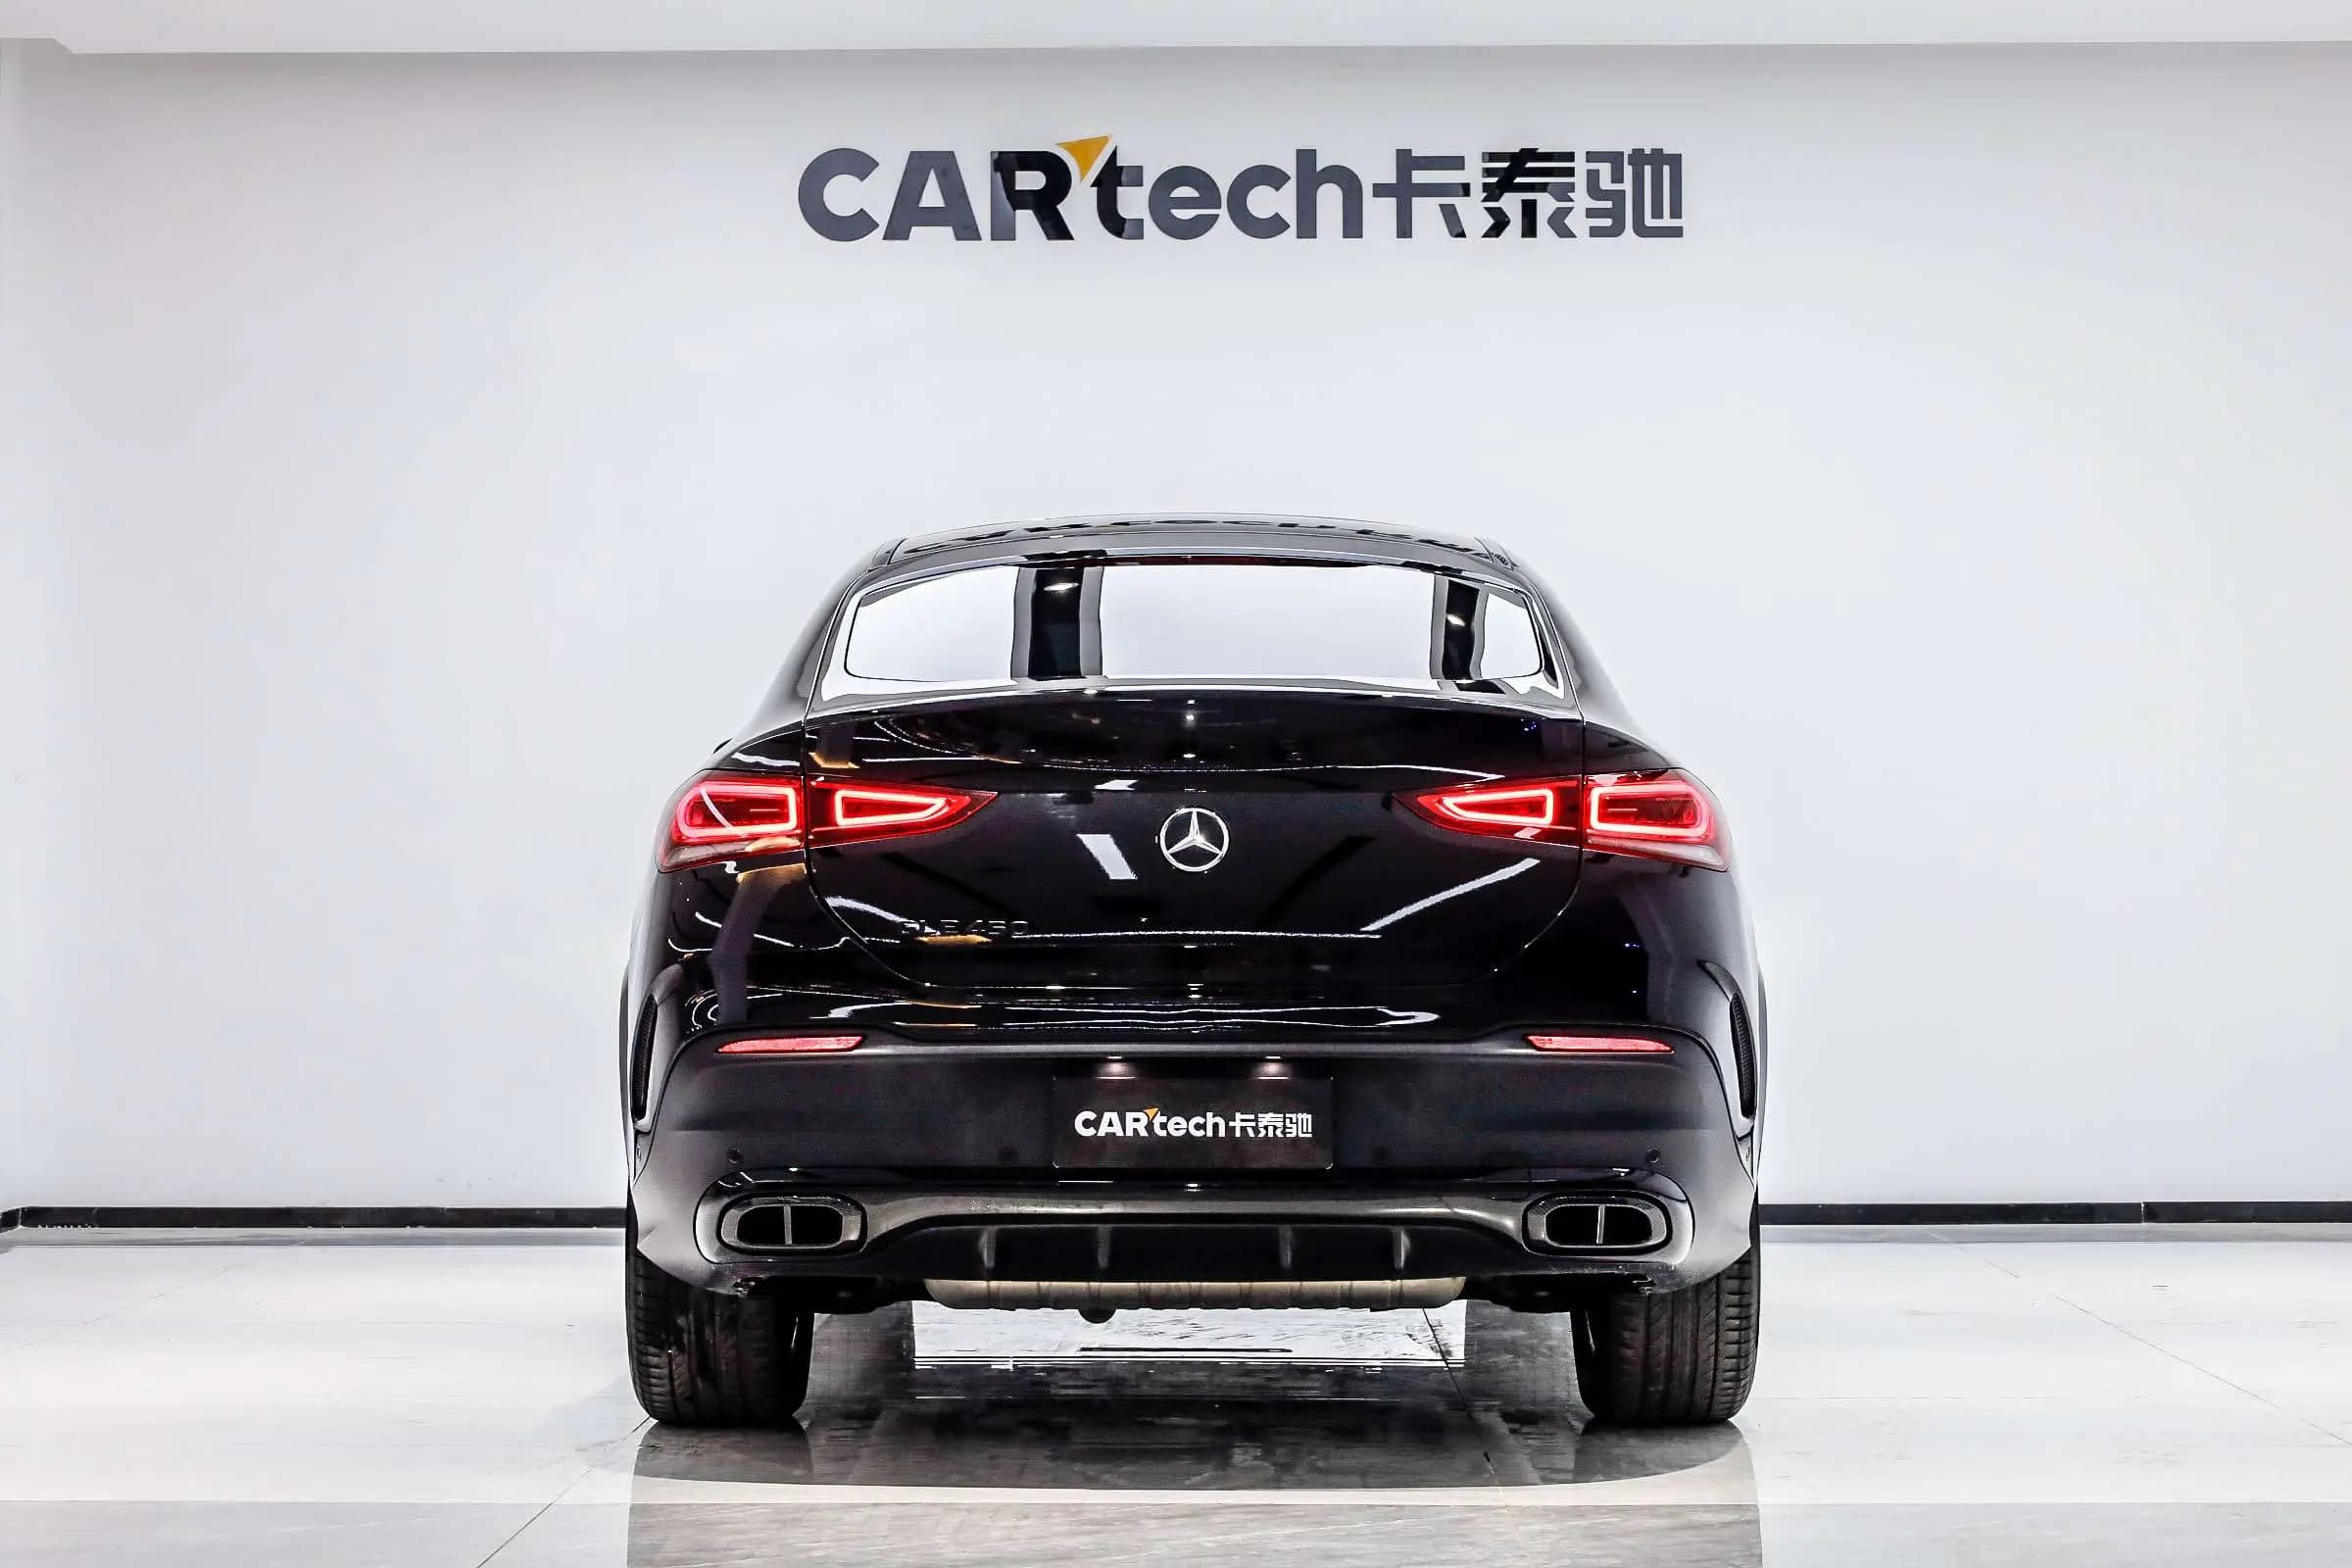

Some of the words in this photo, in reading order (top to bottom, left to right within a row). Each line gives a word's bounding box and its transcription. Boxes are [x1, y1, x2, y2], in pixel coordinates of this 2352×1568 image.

[797, 144, 1364, 242] CARtech
[1371, 147, 1684, 239] 卡泰驰
[1074, 1110, 1226, 1138] CARtech
[1228, 1111, 1313, 1138] 卡泰驰
